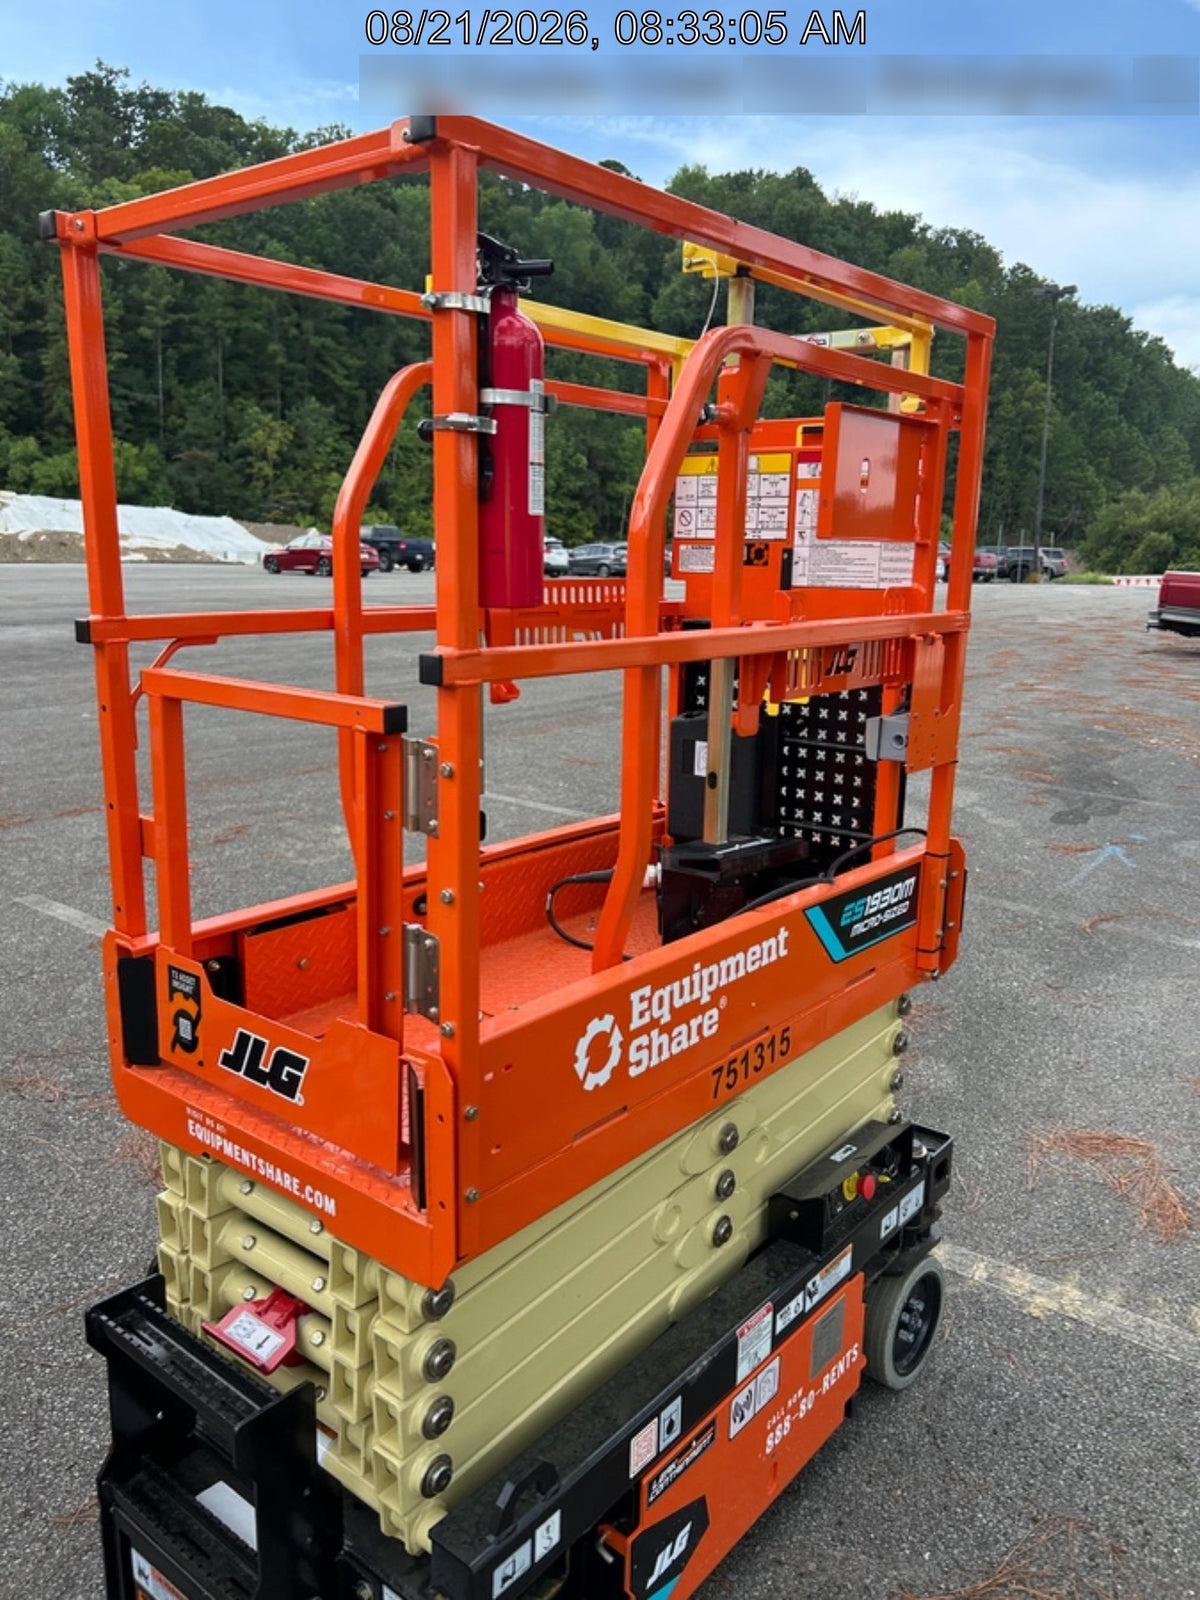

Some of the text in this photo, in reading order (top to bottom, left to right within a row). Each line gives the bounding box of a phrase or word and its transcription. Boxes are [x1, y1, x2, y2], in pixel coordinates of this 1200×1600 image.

[630, 926, 789, 1030] Equipment
[711, 1027, 791, 1099] 751315
[187, 1119, 337, 1217] EQUIPMENTSHARE.COM
[645, 1520, 693, 1590] JLG
